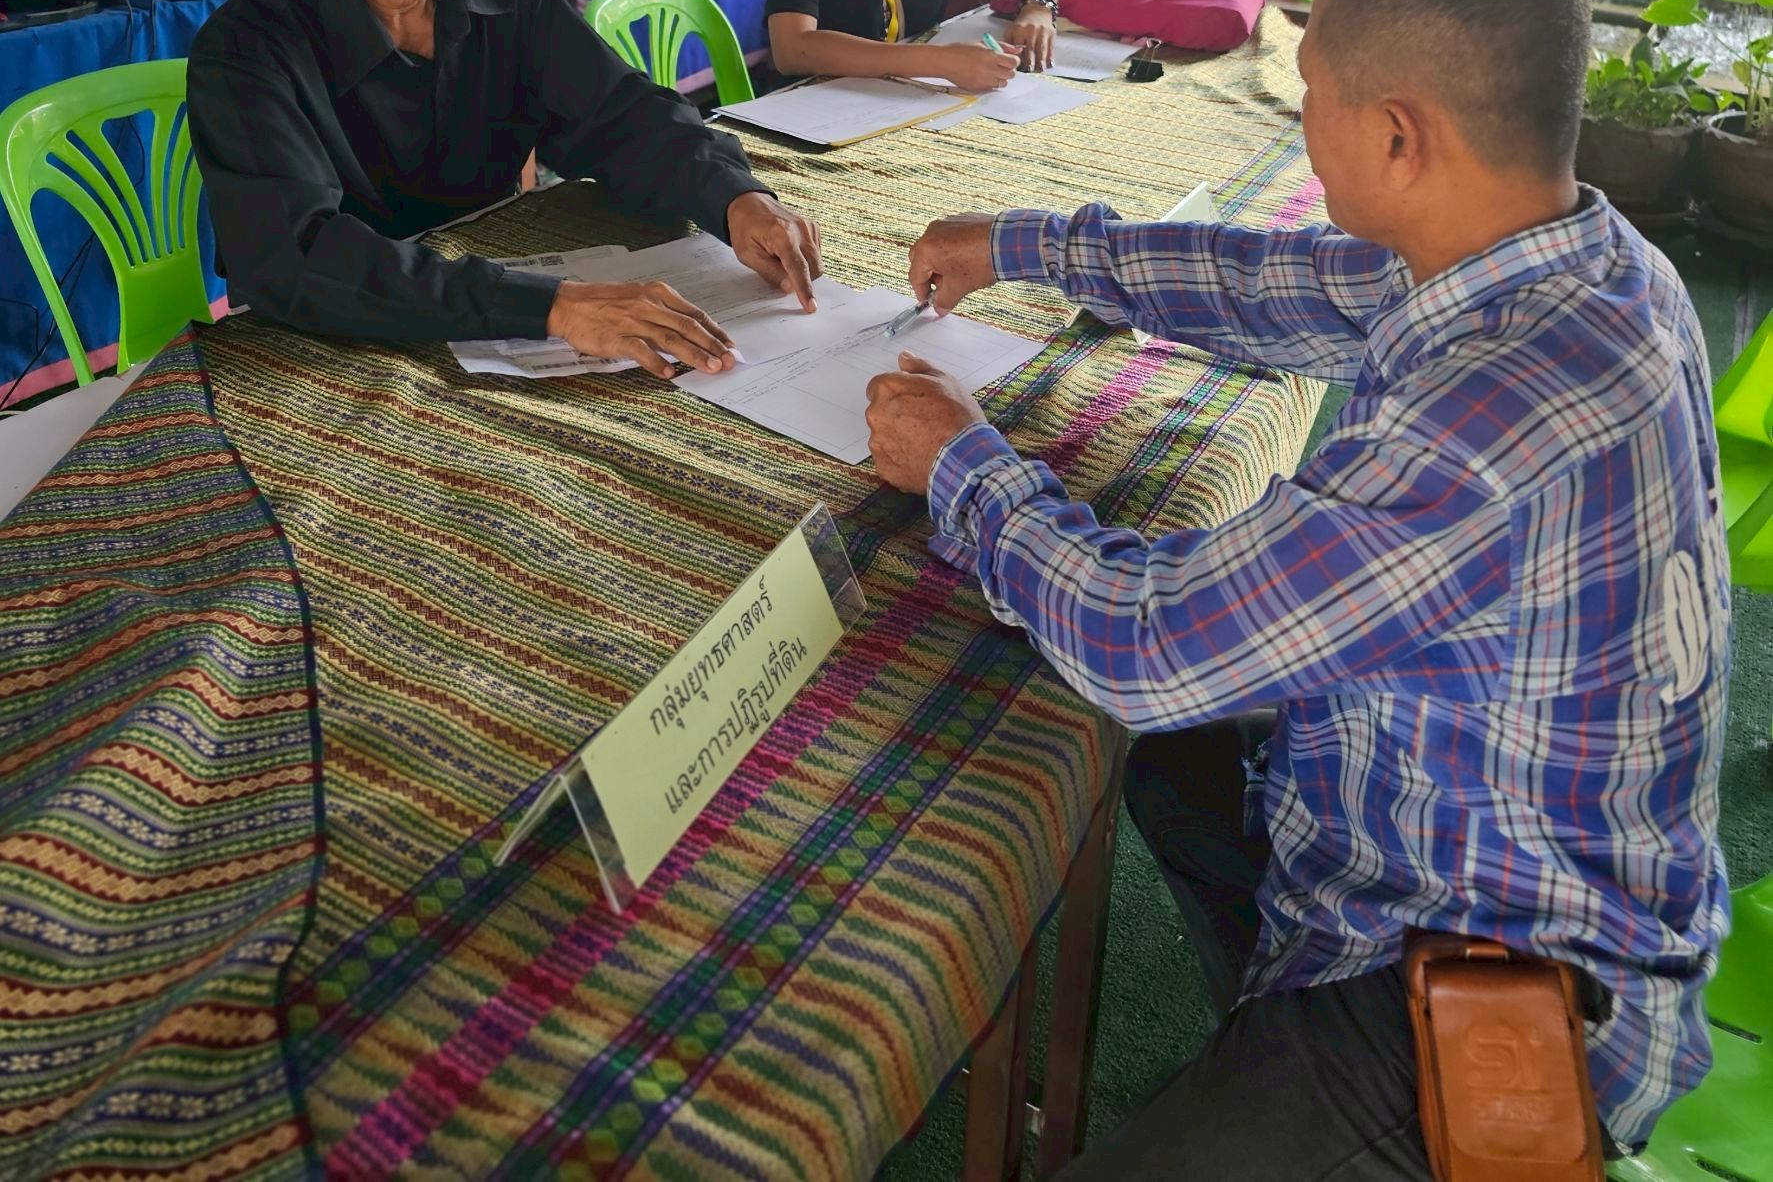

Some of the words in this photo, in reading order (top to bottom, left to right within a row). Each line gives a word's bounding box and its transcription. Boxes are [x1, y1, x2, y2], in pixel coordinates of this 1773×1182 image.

[649, 574, 774, 736] กลุ่มยุทธศาสตร์
[664, 636, 808, 815] และการปฏิรูปที่ดิน
